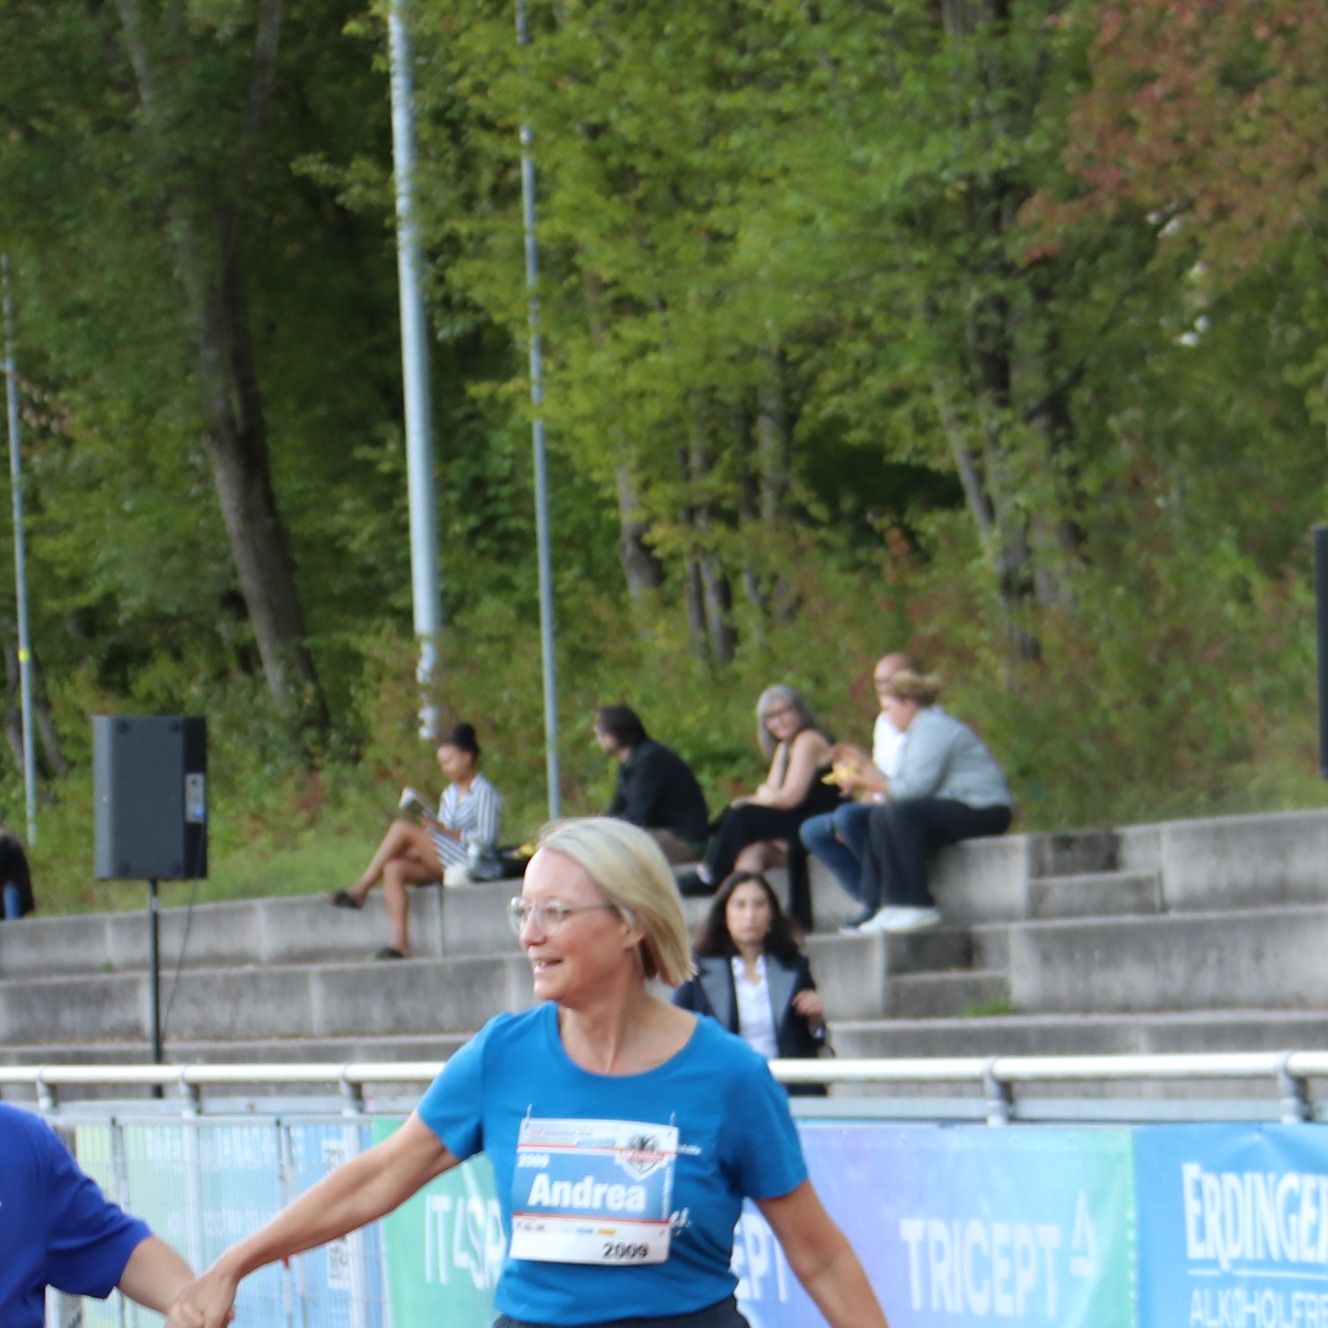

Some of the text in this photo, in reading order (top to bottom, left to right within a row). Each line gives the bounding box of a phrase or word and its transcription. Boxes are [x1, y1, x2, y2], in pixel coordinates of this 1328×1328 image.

[527, 1172, 648, 1213] Andrea
[601, 1241, 649, 1260] 2009
[900, 1218, 1062, 1320] TRICEPT
